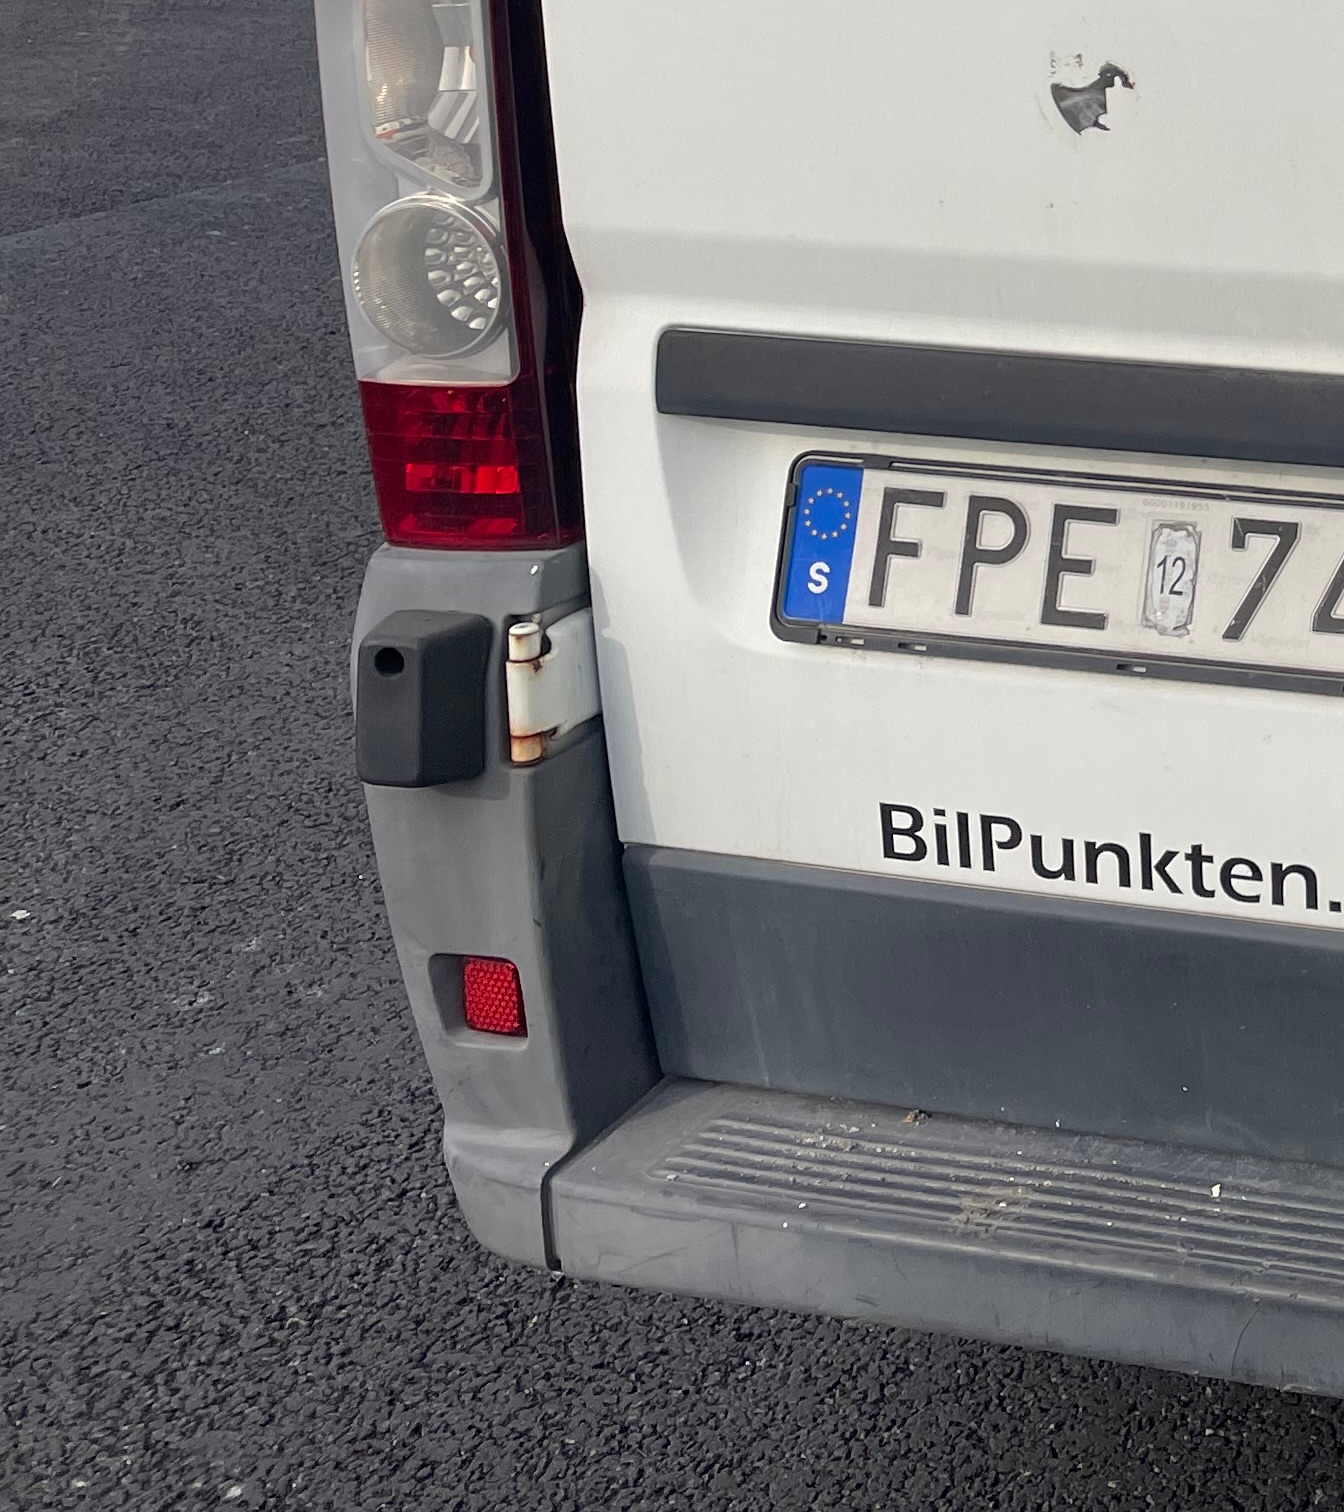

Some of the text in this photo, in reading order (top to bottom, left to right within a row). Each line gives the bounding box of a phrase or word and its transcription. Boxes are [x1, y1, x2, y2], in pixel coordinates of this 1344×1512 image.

[806, 561, 832, 595] S
[868, 486, 1118, 631] FPE
[1156, 554, 1187, 596] 12
